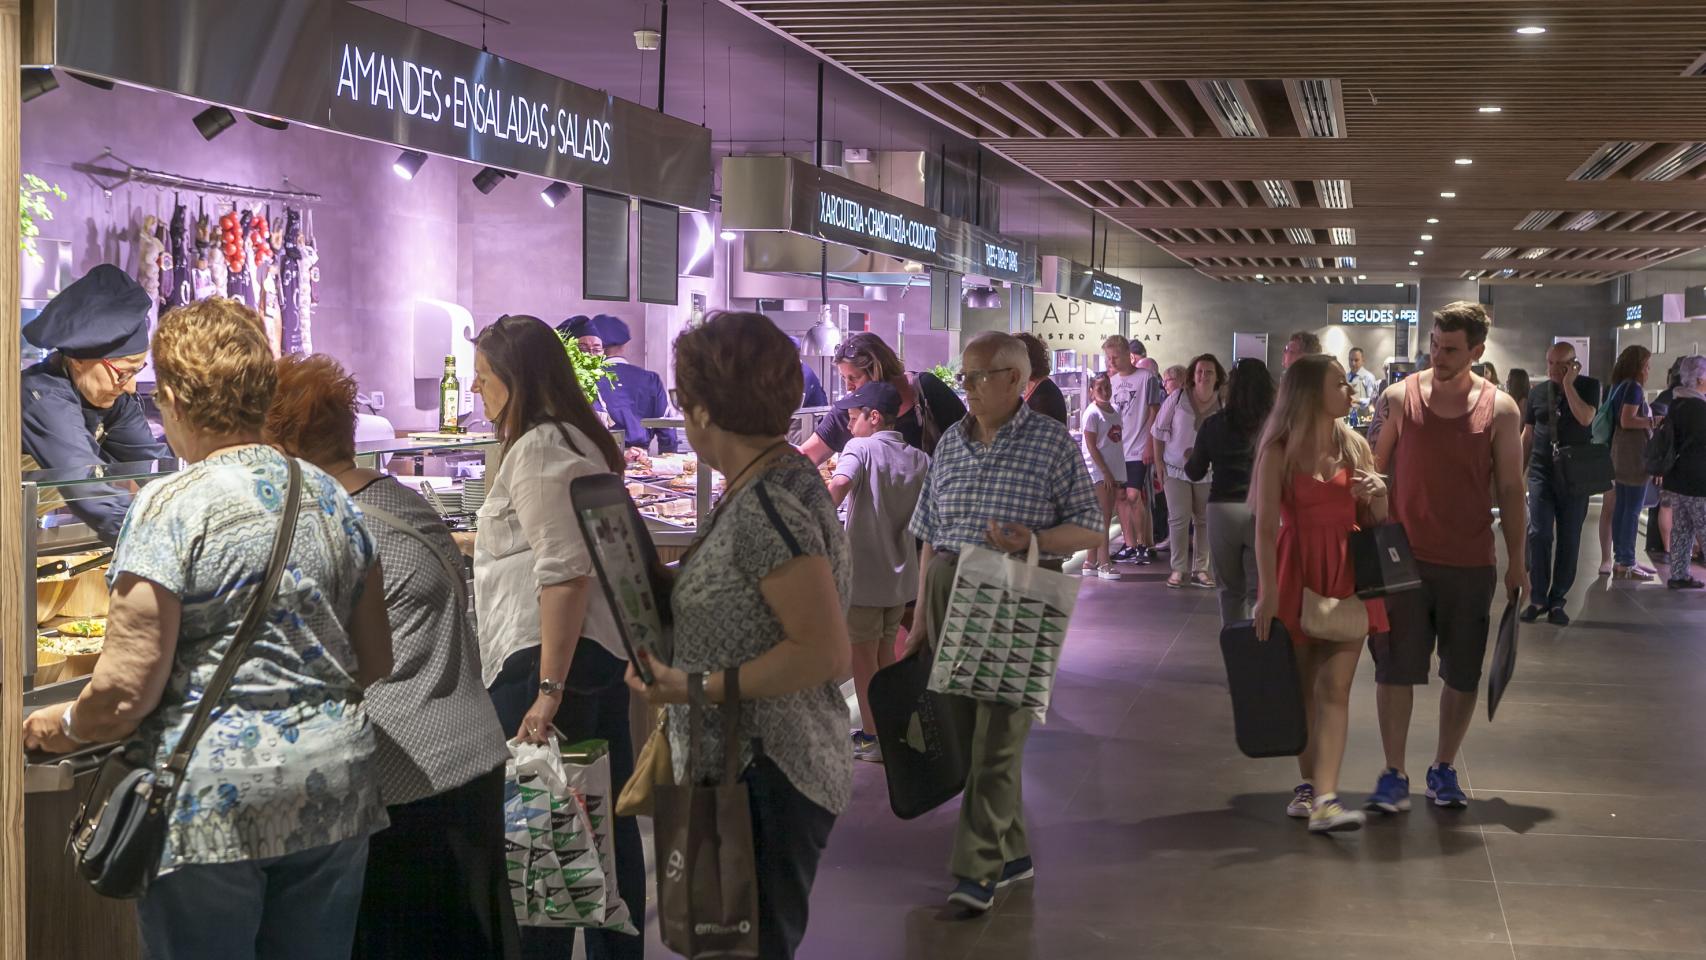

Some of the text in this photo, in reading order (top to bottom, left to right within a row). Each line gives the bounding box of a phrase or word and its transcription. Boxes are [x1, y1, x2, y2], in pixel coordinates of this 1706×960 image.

[453, 76, 549, 150] ENSALADAS
[557, 108, 611, 165] SALADS
[1342, 309, 1394, 323] BEGUDES
